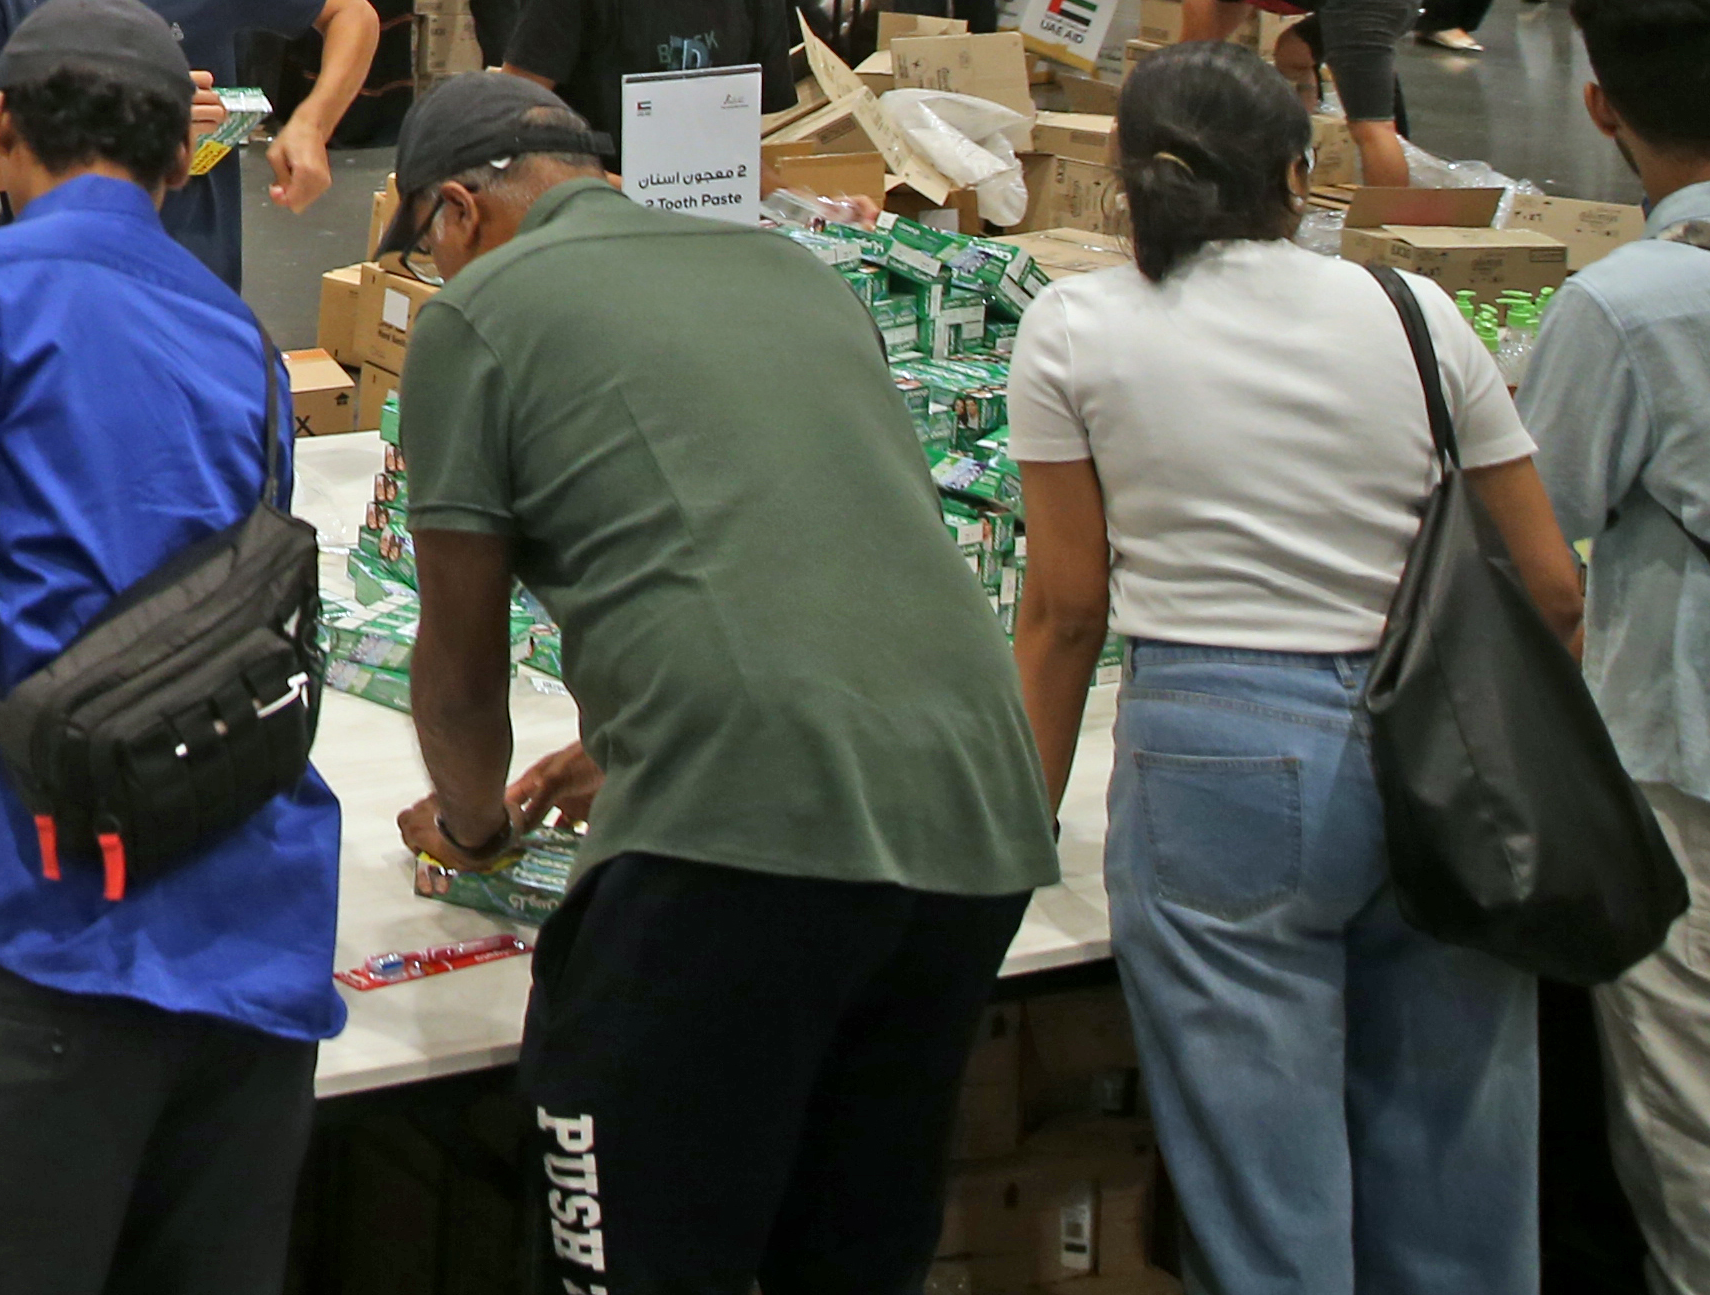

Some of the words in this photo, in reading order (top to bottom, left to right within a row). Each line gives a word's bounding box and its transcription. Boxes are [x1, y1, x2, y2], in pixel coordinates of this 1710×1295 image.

[1040, 19, 1062, 36] UAE
[1064, 30, 1084, 44] AID
[638, 171, 680, 190] اسنان
[682, 167, 734, 186] معجون
[737, 164, 747, 178] 2
[658, 195, 698, 211] Tooth
[701, 192, 742, 207] Paste
[537, 1105, 606, 1272] PUSH
